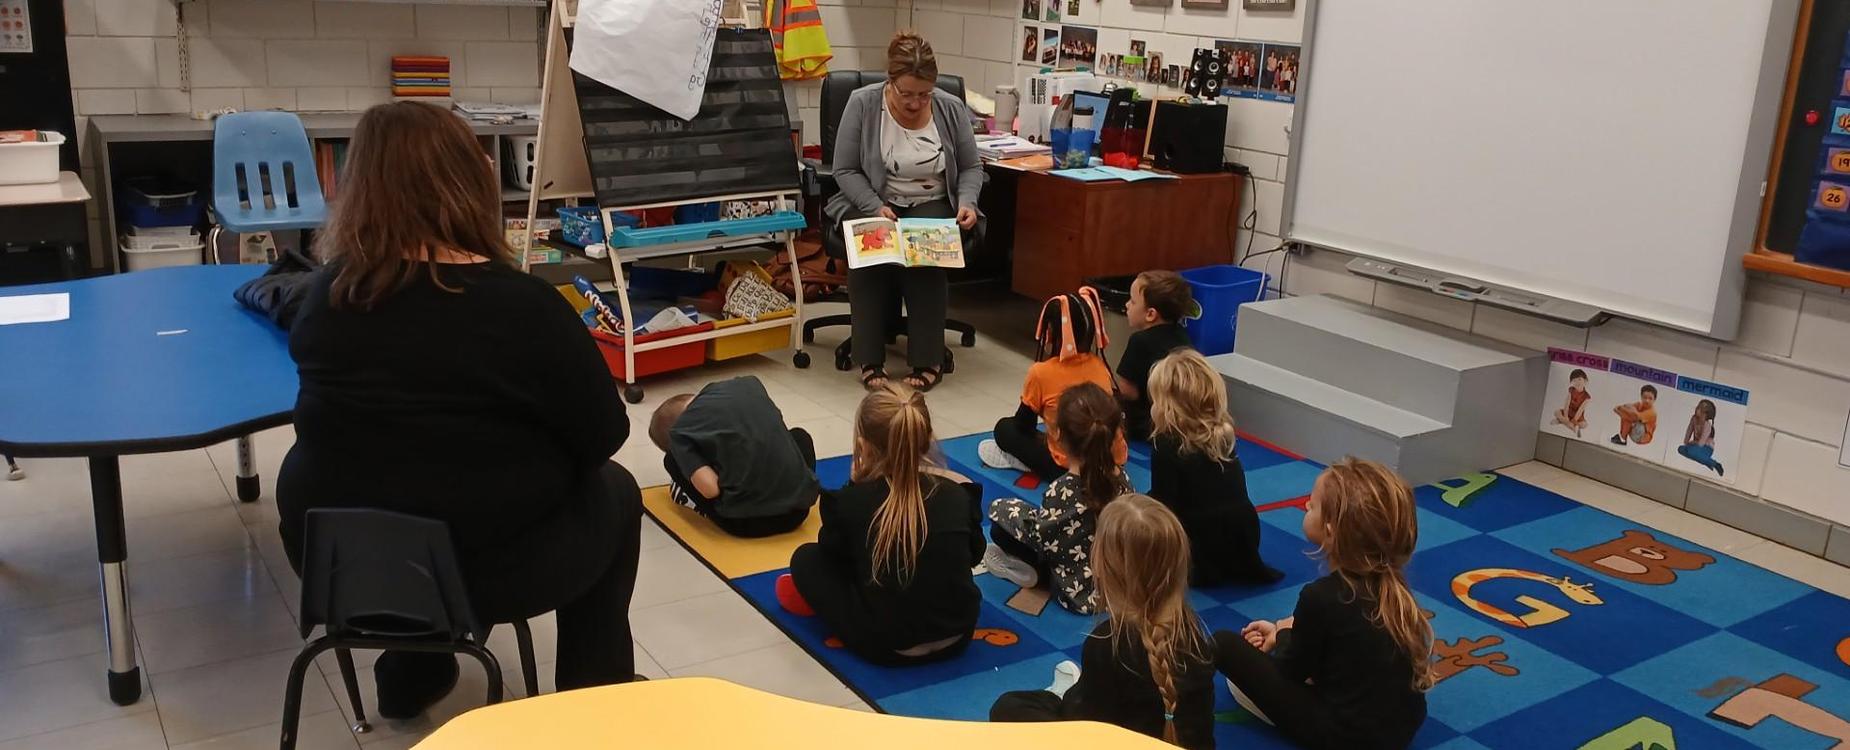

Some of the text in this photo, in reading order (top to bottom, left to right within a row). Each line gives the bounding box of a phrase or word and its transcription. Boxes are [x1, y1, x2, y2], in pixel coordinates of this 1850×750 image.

[1838, 157, 1850, 167] 19
[1826, 192, 1841, 203] 26
[1615, 362, 1673, 384] mountain
[1682, 378, 1745, 402] mermaid
